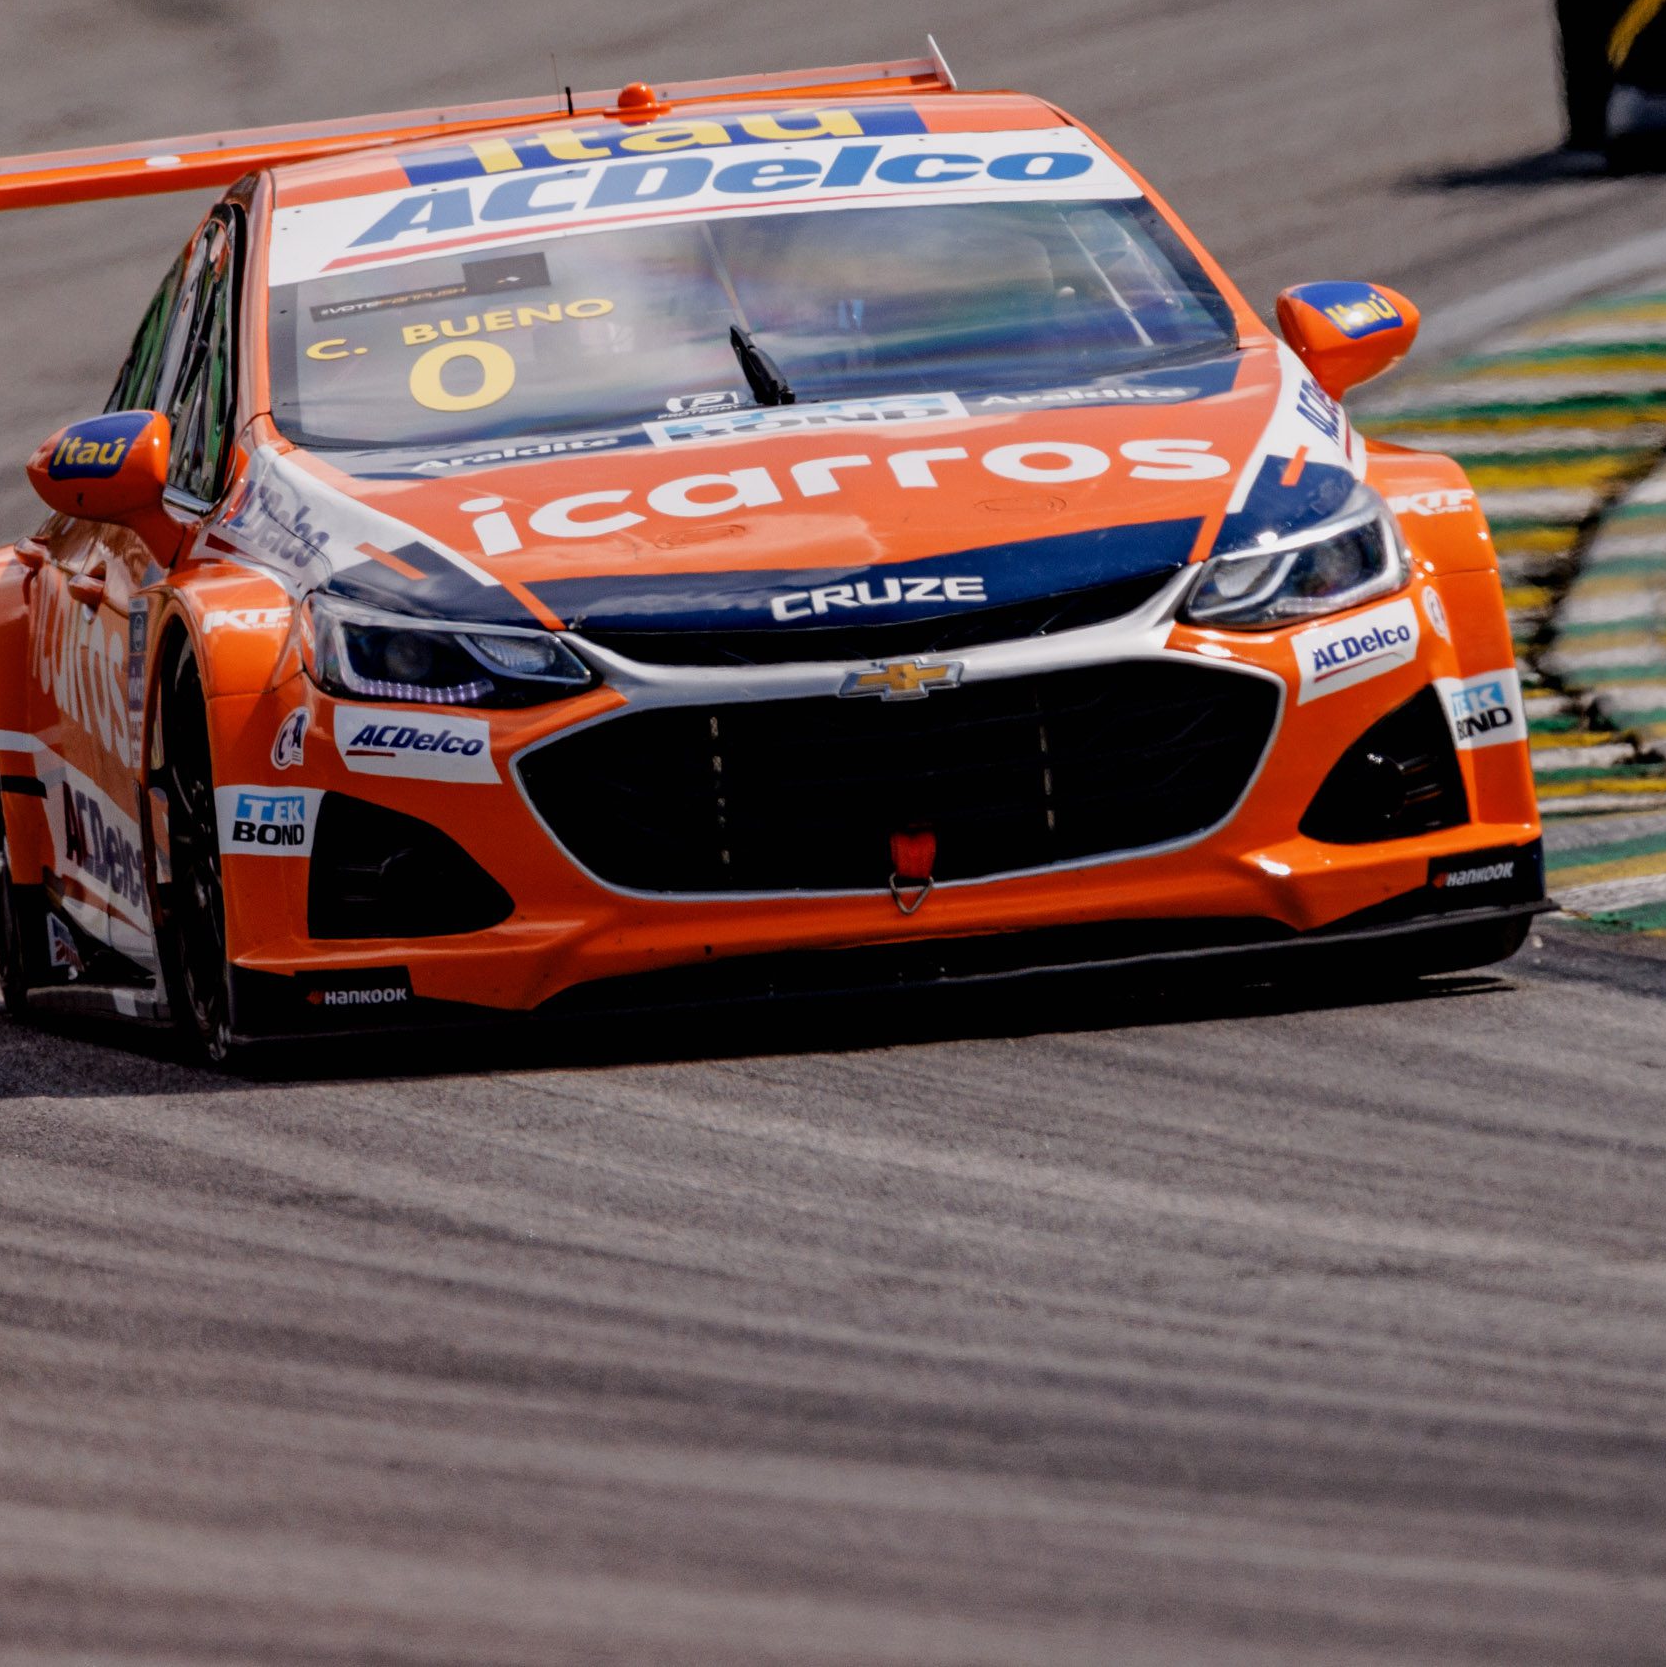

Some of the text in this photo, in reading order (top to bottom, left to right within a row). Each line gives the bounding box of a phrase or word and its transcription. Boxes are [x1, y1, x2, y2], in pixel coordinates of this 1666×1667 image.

[467, 107, 864, 173] Itaú
[346, 145, 1094, 249] ACDelco
[306, 298, 614, 360] C. BUENO
[981, 388, 1189, 407] Araldite
[53, 437, 126, 466] Itaú
[410, 437, 621, 472] Araldite
[459, 439, 1231, 556] icarros
[770, 576, 988, 622] CRUZE
[1314, 625, 1411, 672] ACDelco
[349, 724, 484, 756] ACDelco
[236, 794, 305, 822] TEK
[232, 820, 305, 846] BOND
